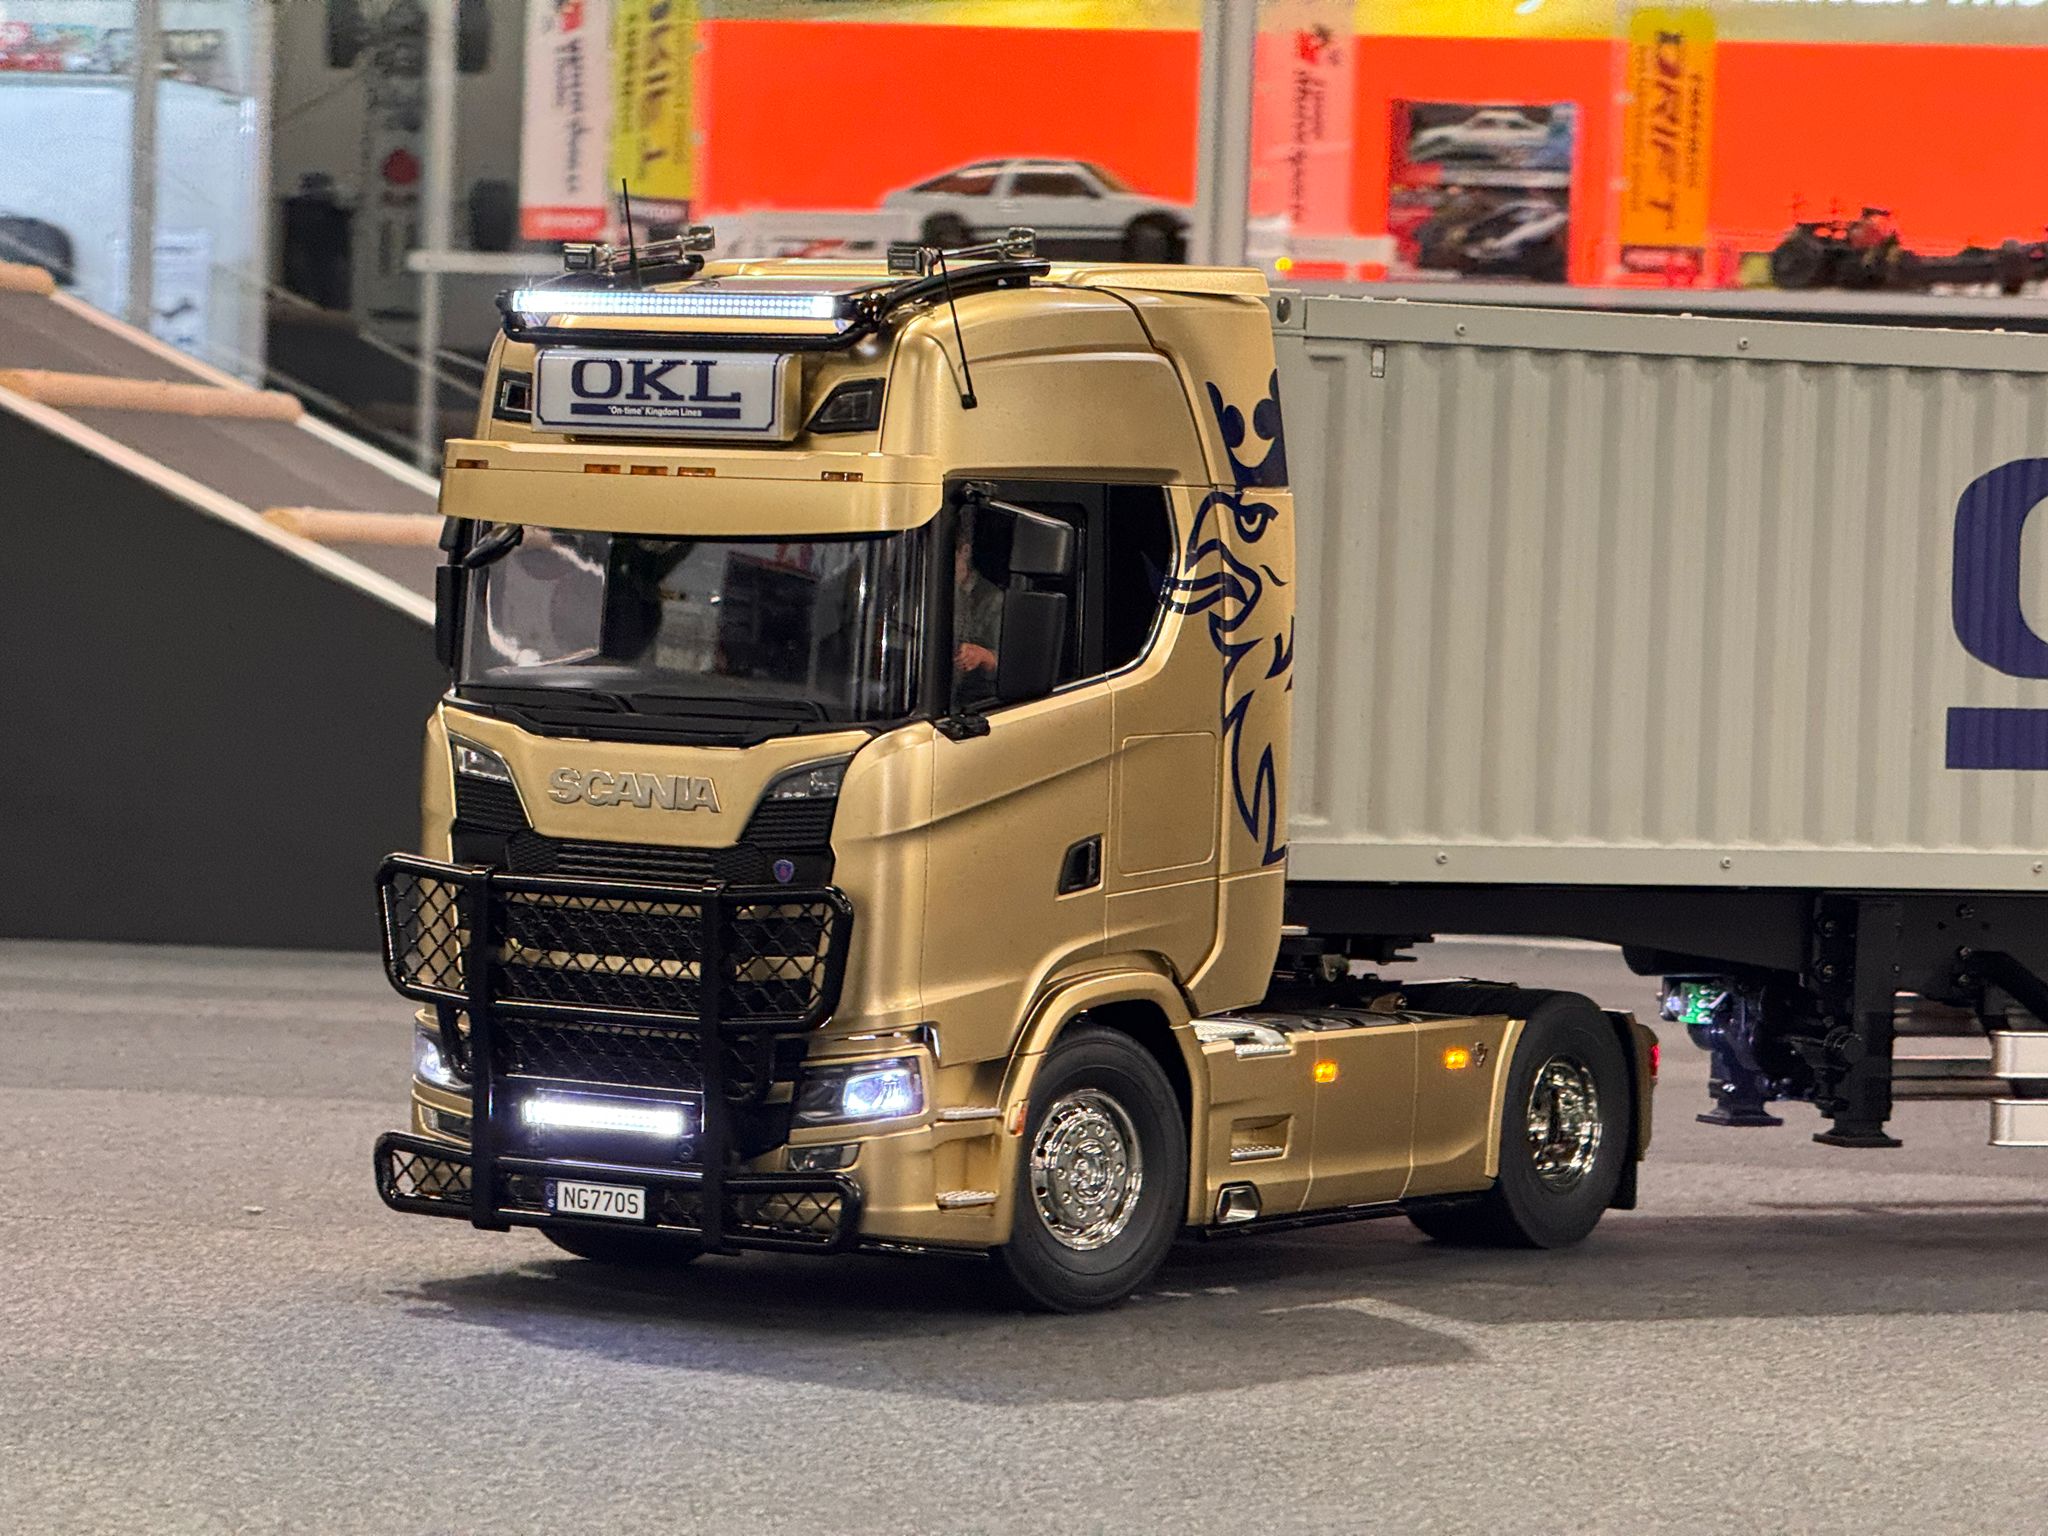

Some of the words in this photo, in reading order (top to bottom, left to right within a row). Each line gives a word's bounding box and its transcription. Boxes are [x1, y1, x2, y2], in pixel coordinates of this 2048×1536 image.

[571, 359, 741, 402] OKL
[645, 406, 680, 418] Kingdom
[680, 407, 703, 418] Lines
[547, 766, 722, 814] SCANIA
[564, 1187, 639, 1214] NG770S
